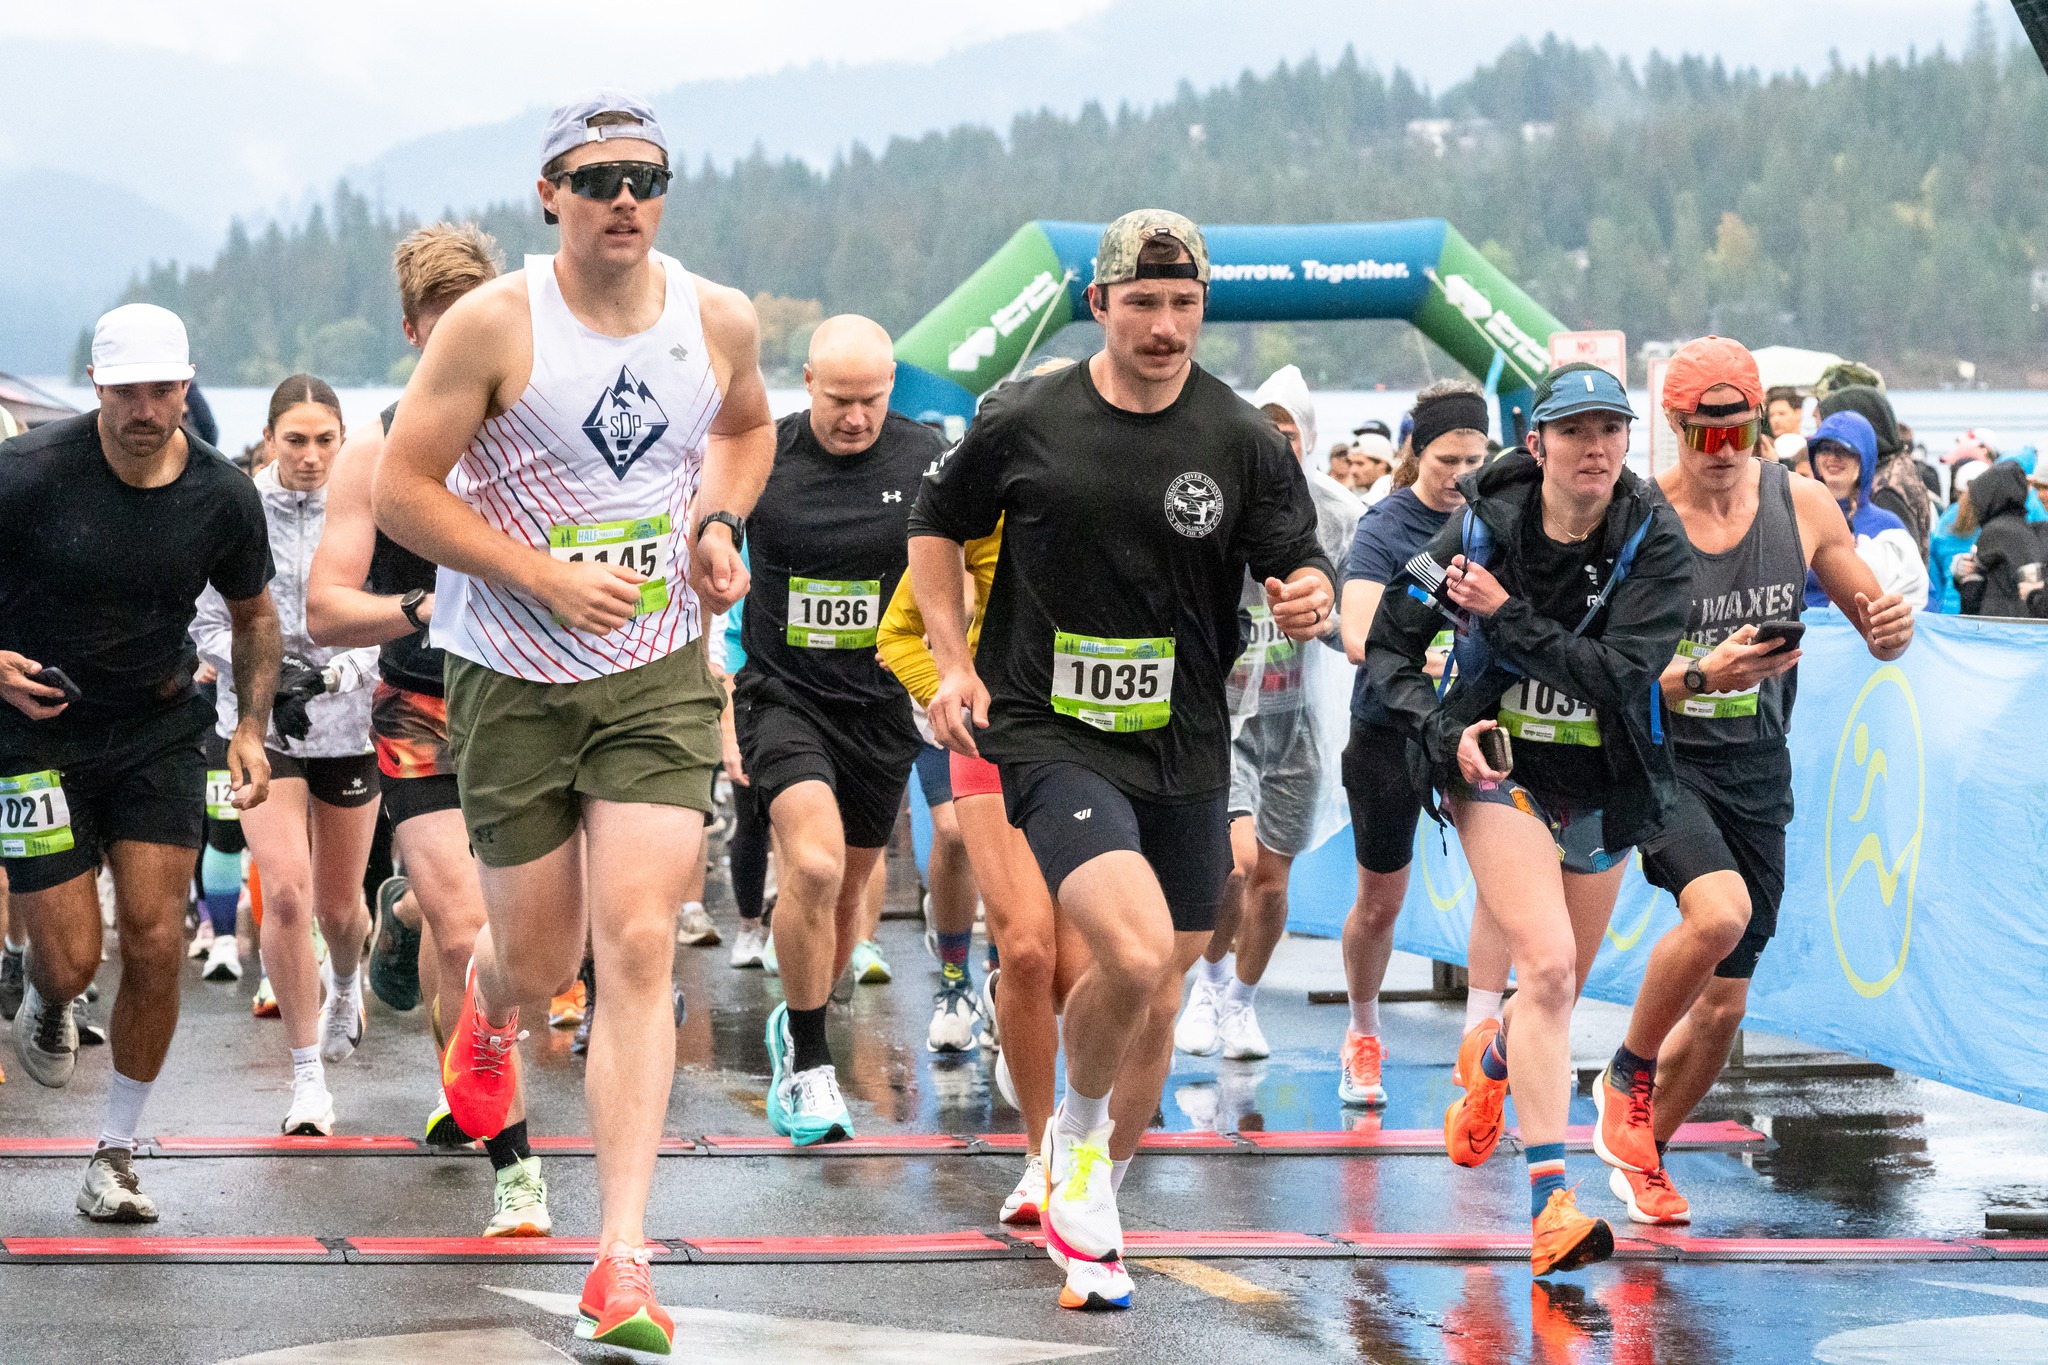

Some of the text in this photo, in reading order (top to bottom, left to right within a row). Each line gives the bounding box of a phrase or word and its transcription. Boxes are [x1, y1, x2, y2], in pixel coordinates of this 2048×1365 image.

[1209, 259, 1410, 284] morrow. Together.
[610, 412, 642, 439] SDP
[578, 529, 598, 542] HALF
[569, 542, 657, 578] 45
[801, 598, 868, 626] 1036
[1701, 583, 1795, 626] MAXES
[1071, 661, 1158, 700] 1035
[0, 793, 54, 828] 021
